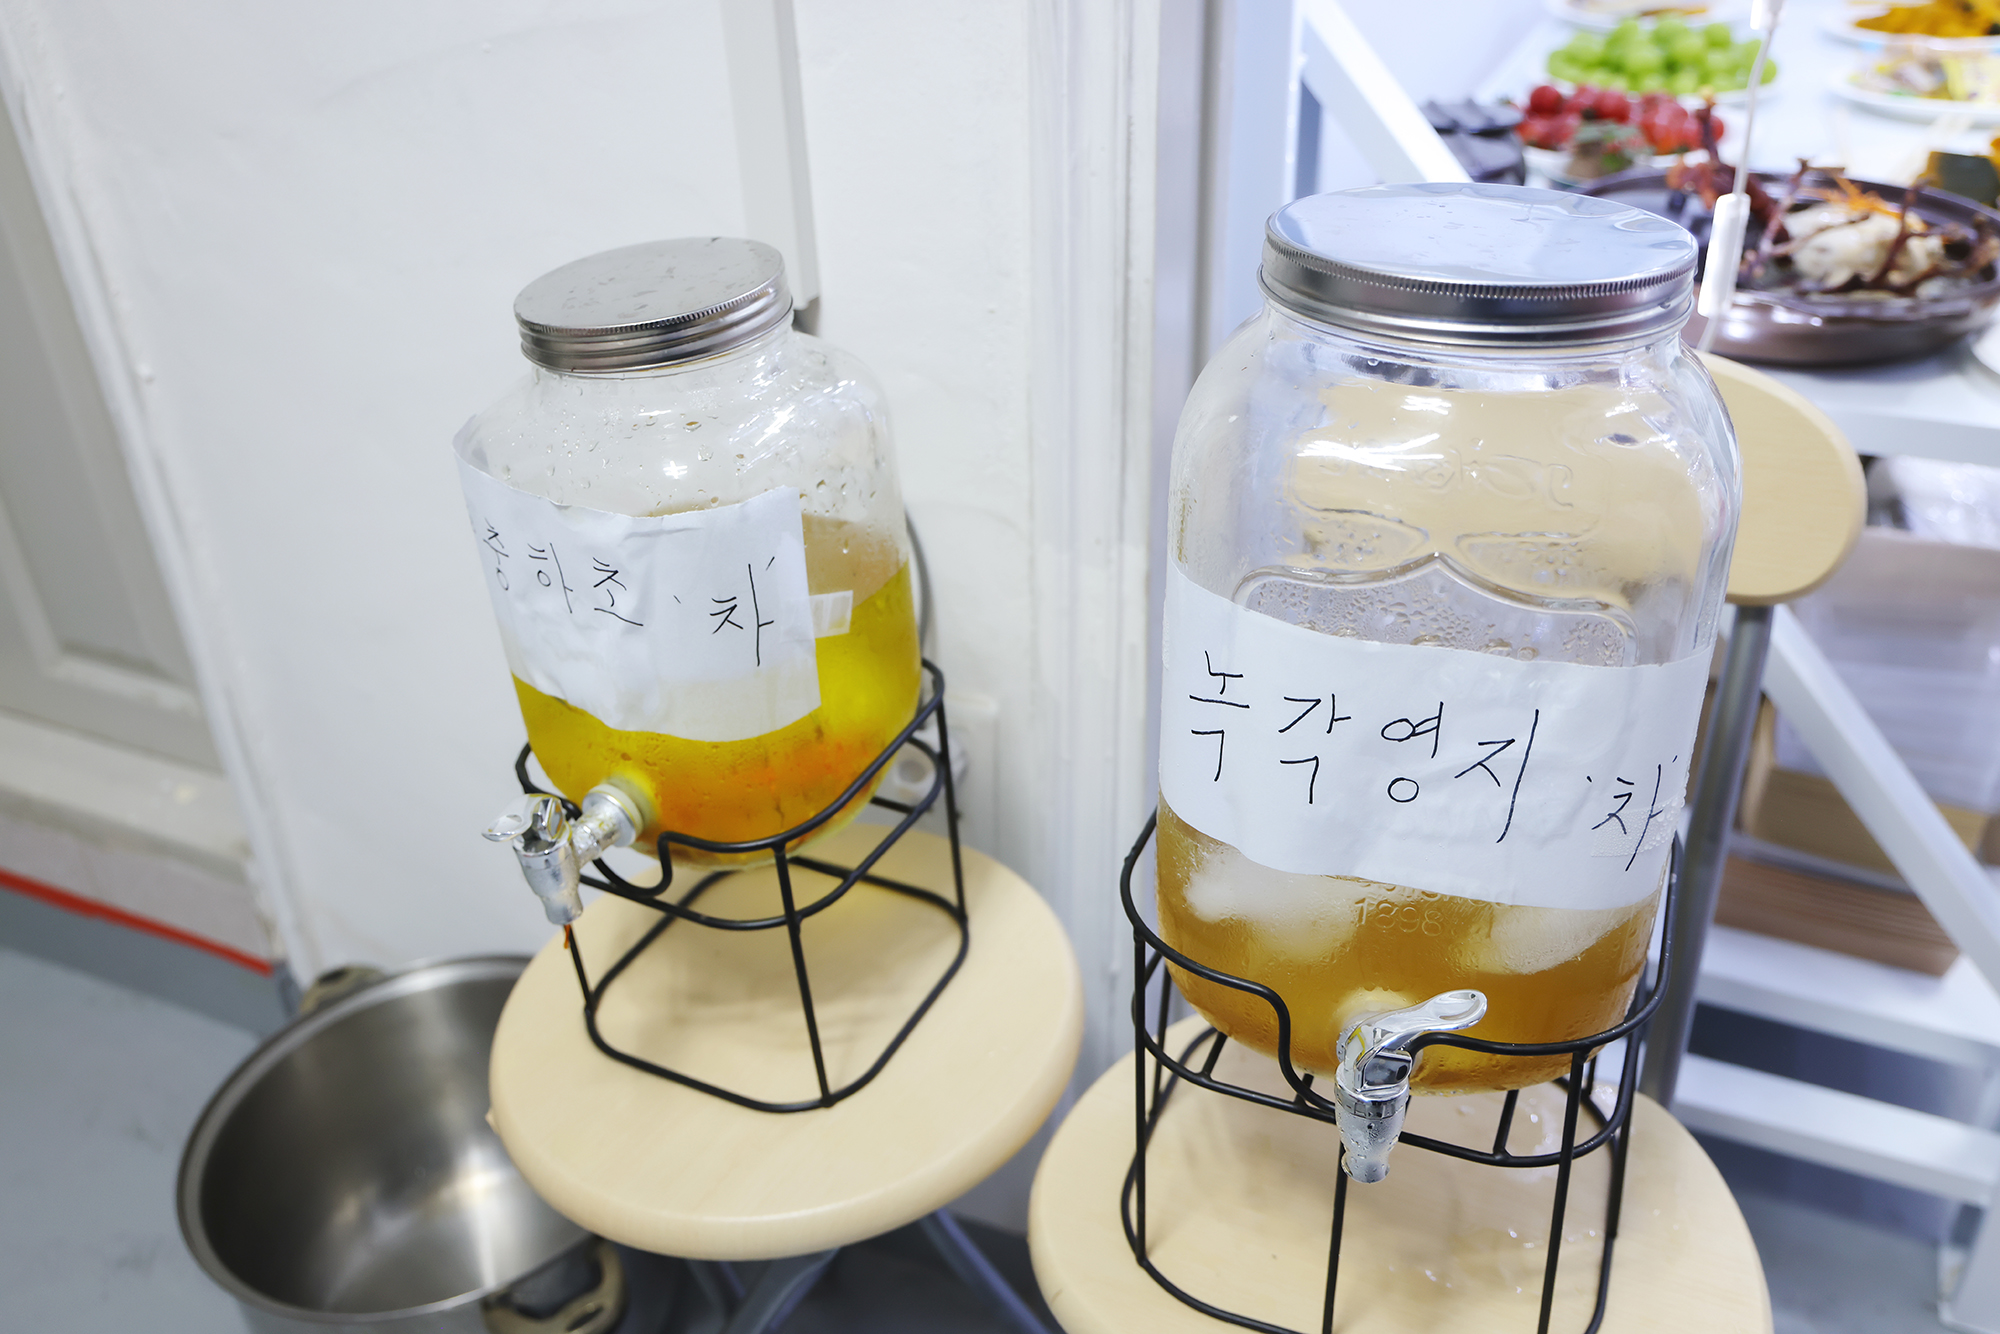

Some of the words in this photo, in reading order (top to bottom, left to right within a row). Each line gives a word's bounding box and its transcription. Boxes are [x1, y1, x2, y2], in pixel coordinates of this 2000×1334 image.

[470, 516, 645, 628] 충하초
[1188, 649, 1540, 844] 녹각영지
[1354, 897, 1445, 937] 1898
